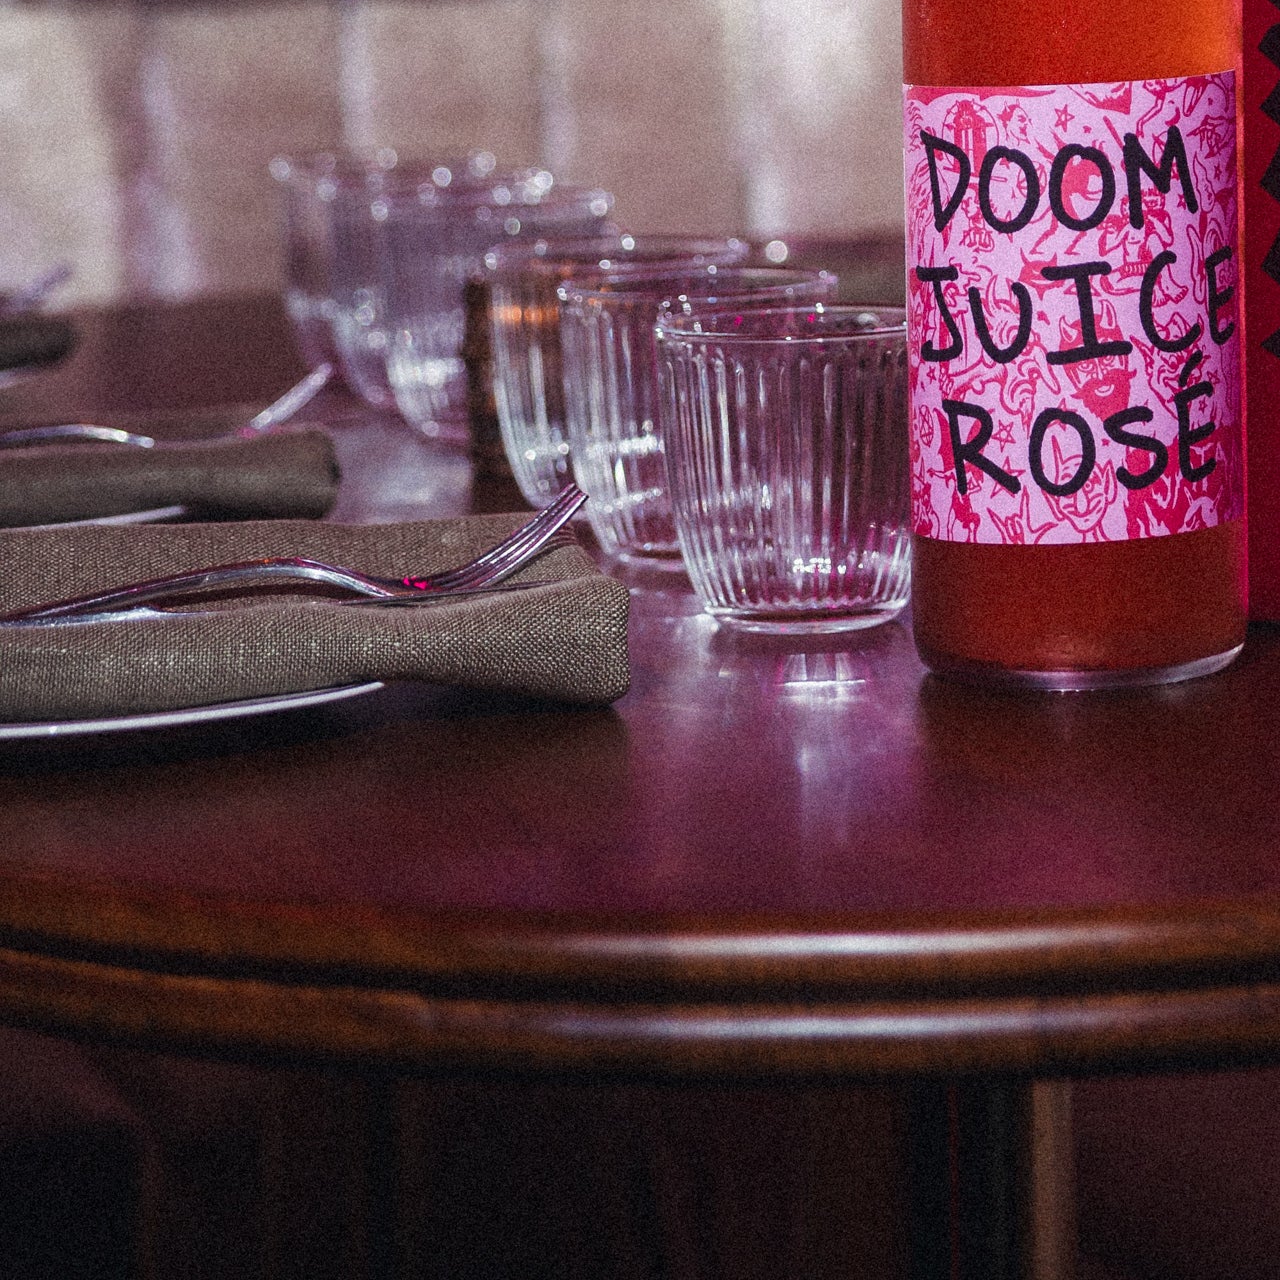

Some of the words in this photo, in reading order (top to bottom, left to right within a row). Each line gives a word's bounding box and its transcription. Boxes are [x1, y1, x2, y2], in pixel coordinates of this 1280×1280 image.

[919, 126, 1198, 234] DOOM
[915, 246, 1234, 364] JUICE
[943, 351, 1216, 496] ROSÉ
